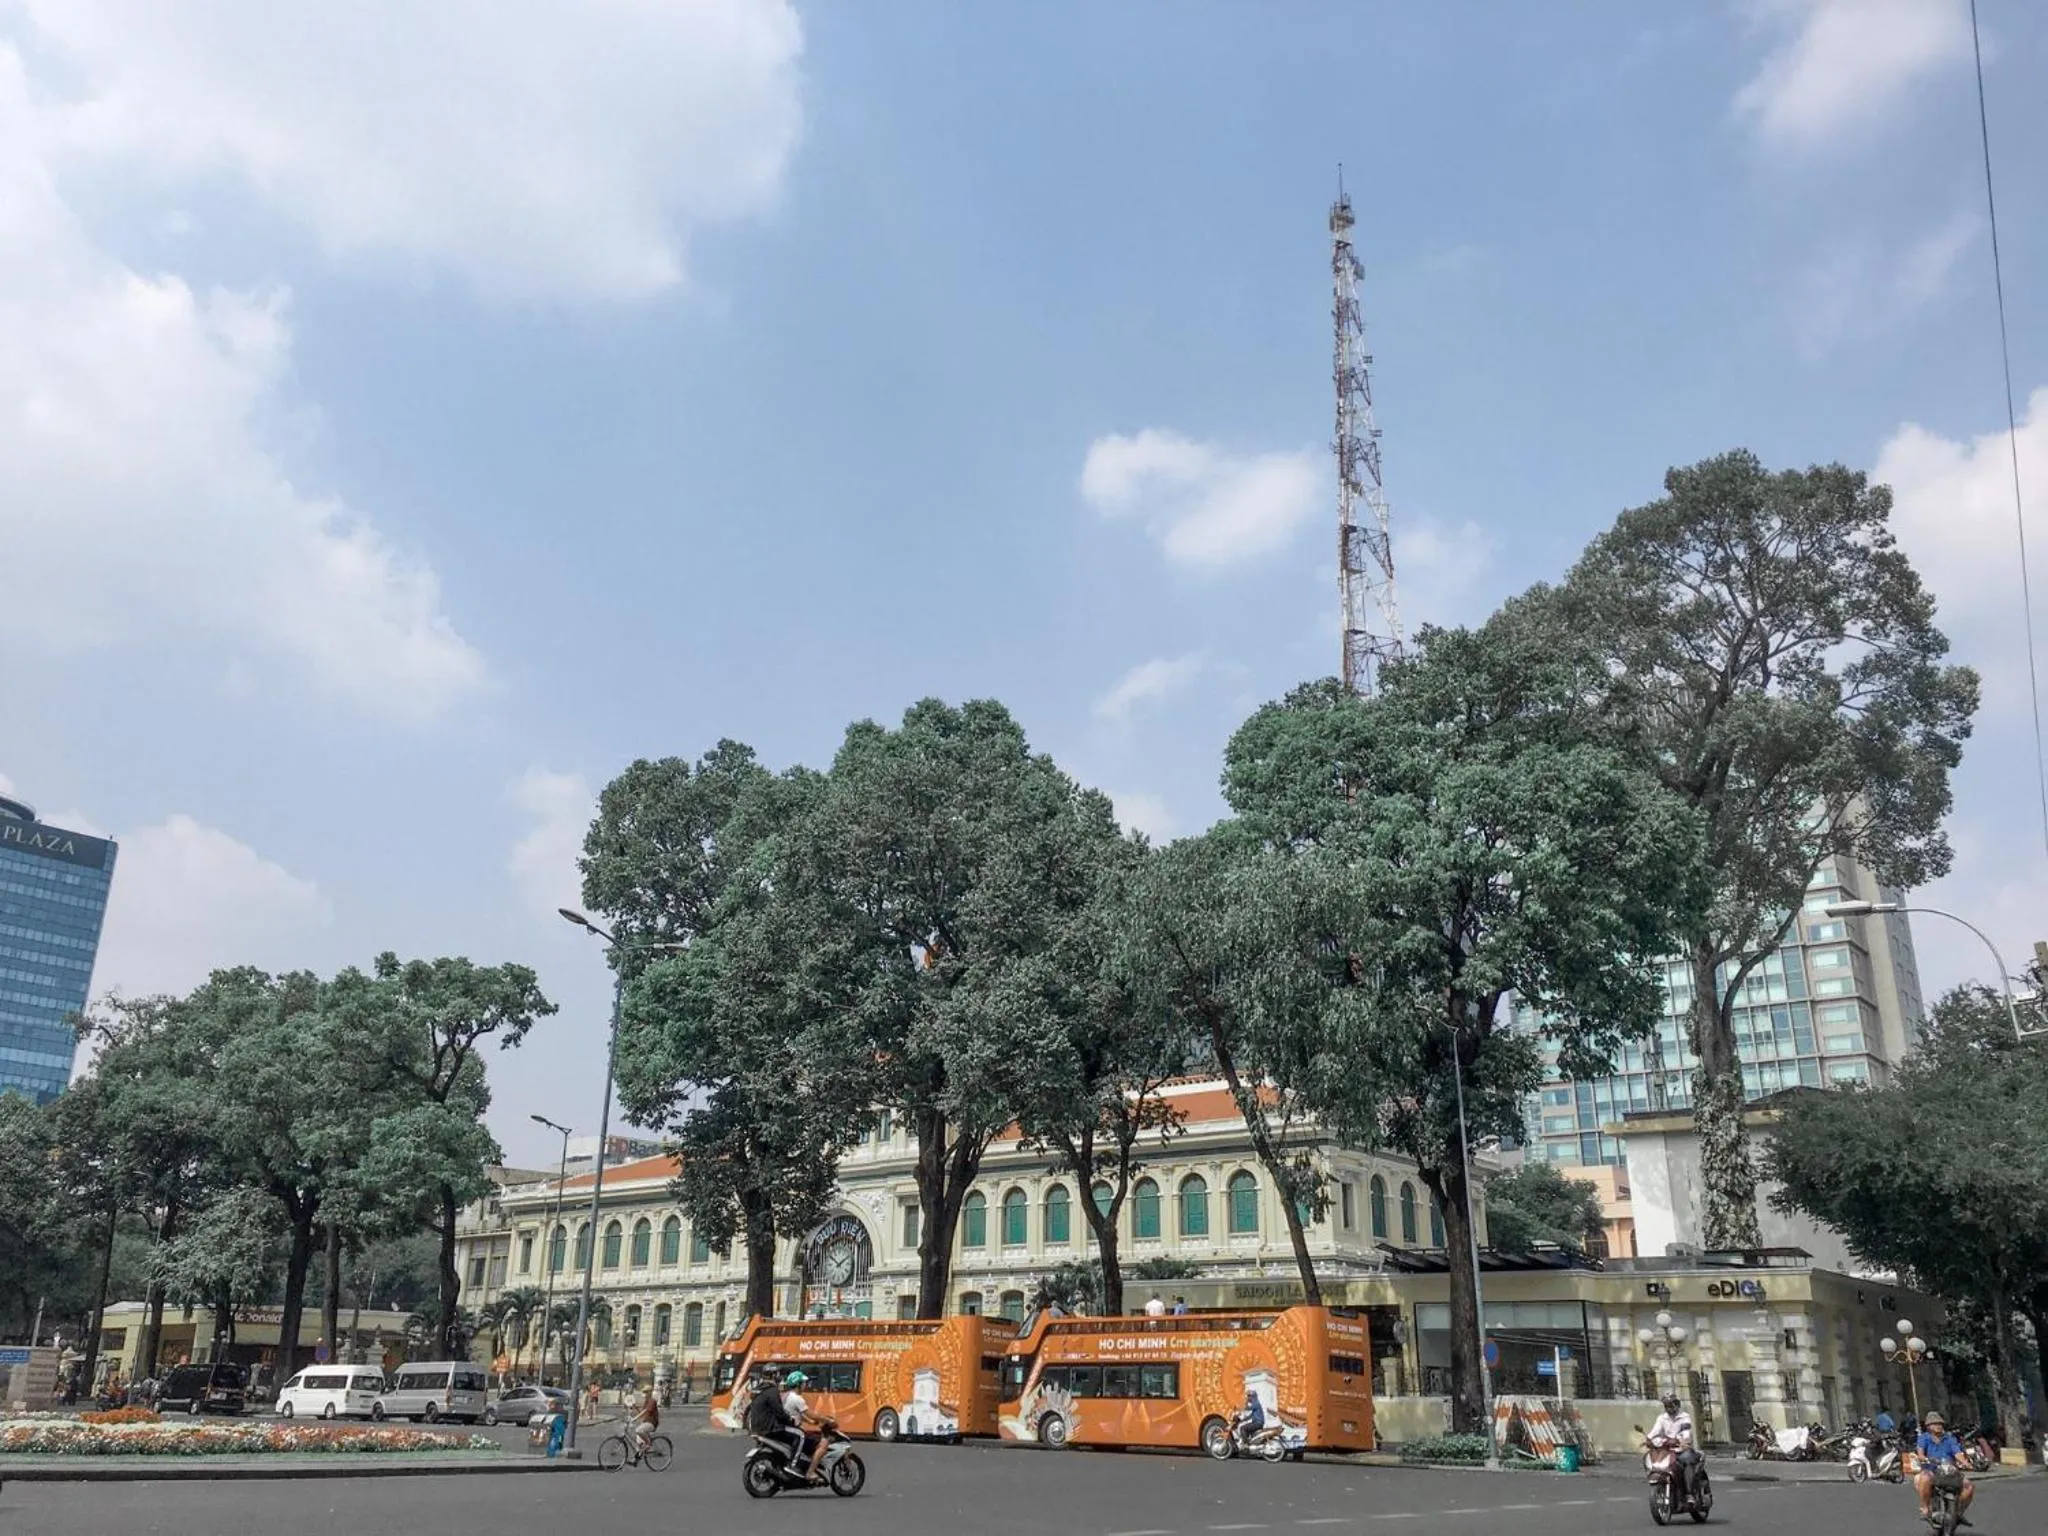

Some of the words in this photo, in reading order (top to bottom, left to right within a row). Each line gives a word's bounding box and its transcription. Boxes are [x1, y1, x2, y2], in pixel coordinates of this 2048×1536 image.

[3, 825, 75, 856] PLAZA
[799, 1340, 813, 1351] HO
[813, 1340, 830, 1351] CHI
[831, 1340, 855, 1350] MINH
[1098, 1338, 1114, 1350] HO
[1116, 1338, 1136, 1350] CHI
[1138, 1337, 1167, 1349] MINH
